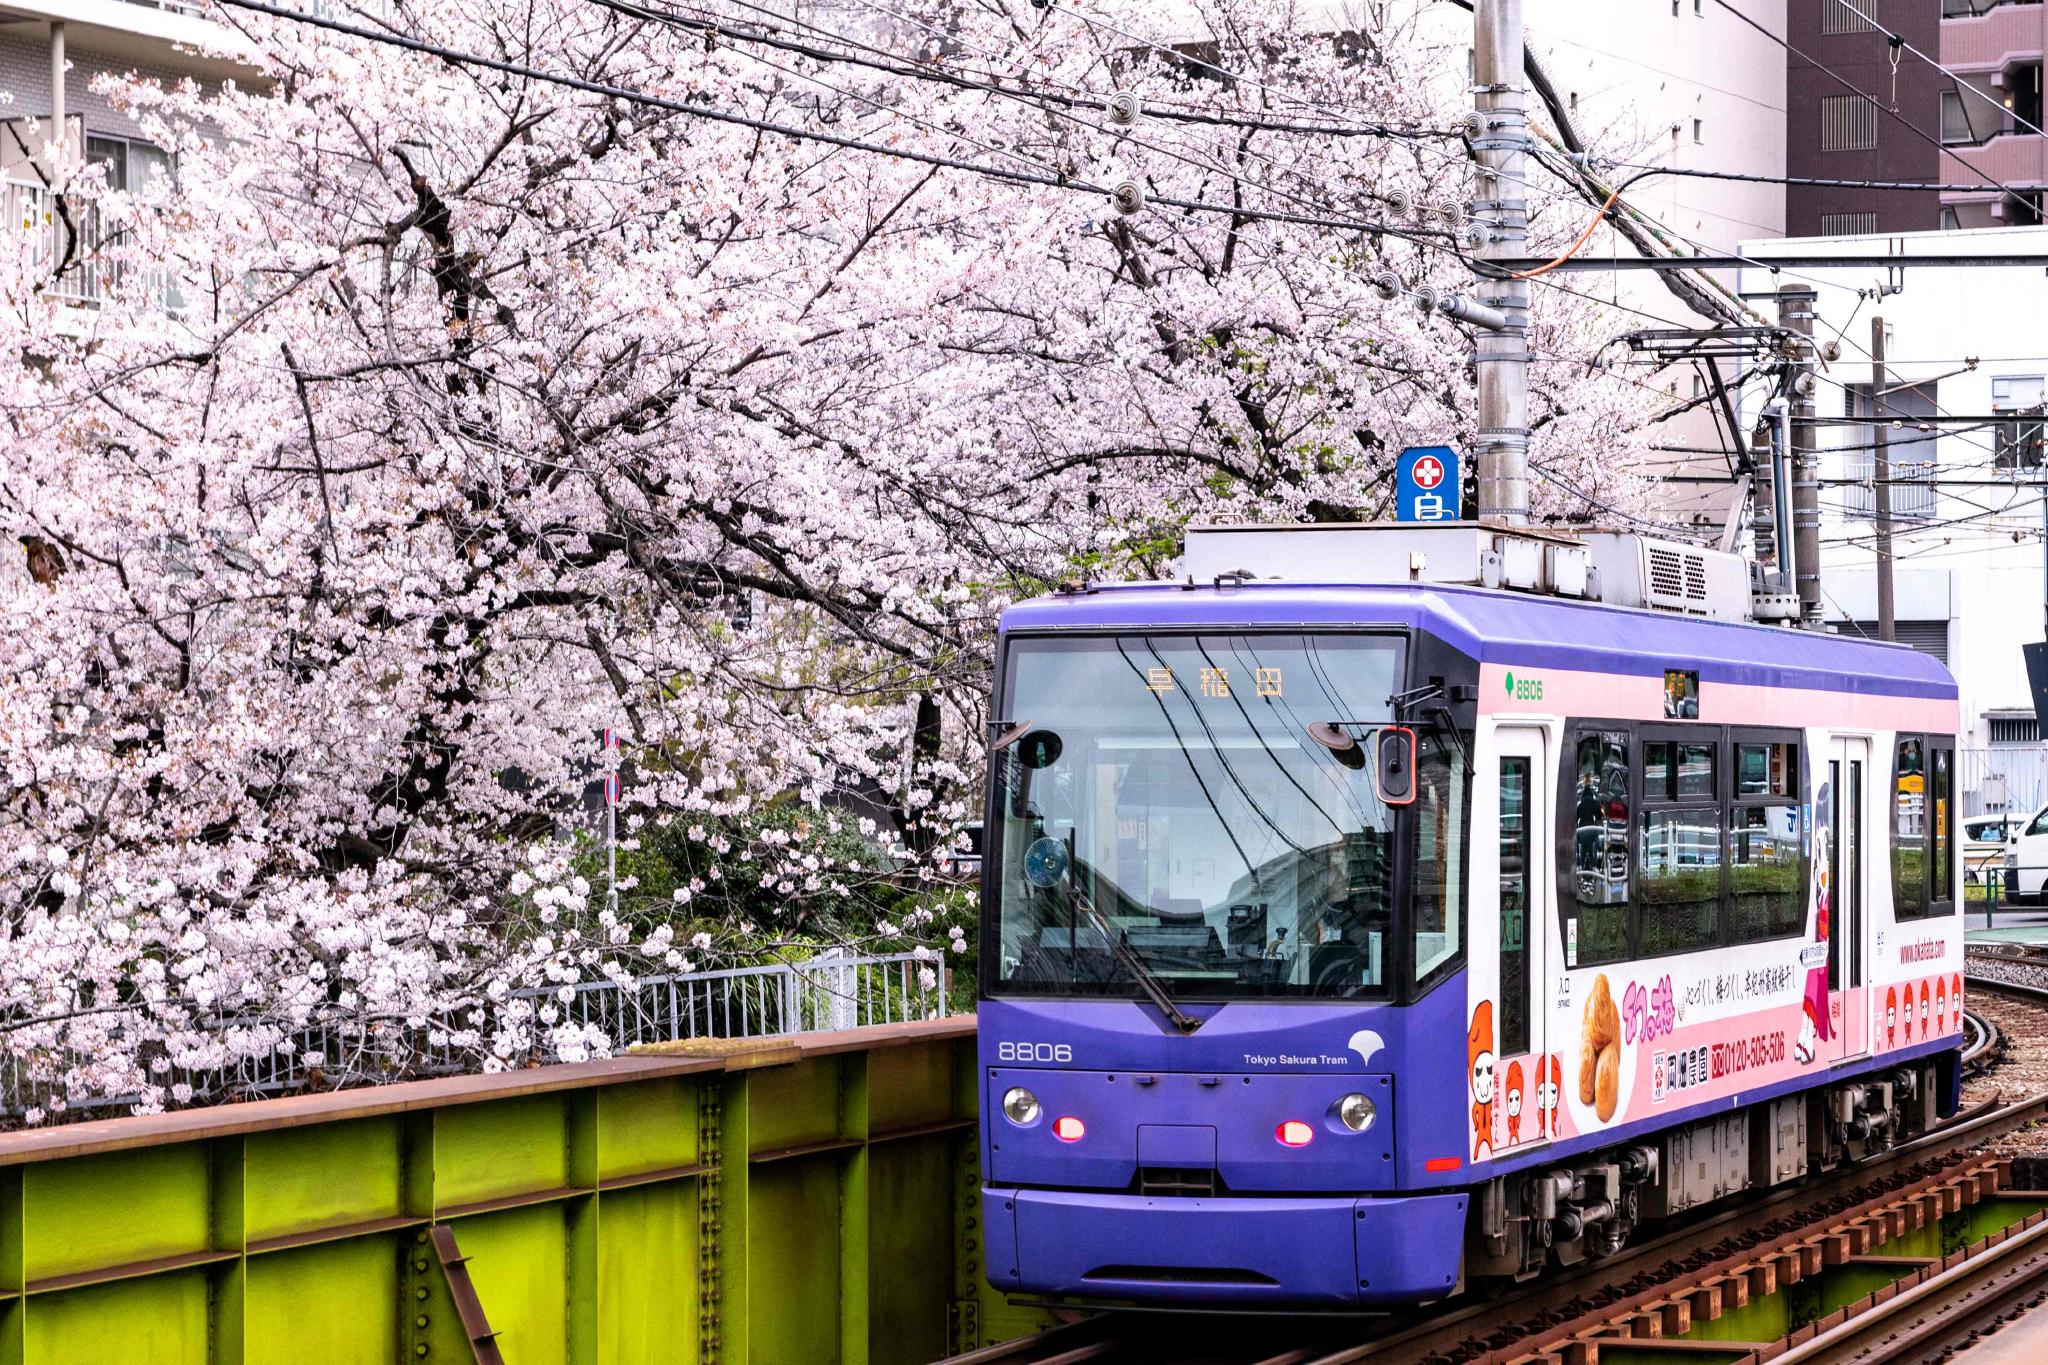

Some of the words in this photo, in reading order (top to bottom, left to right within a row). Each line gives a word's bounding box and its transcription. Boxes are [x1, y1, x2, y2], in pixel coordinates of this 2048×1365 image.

[1414, 491, 1443, 522] 白
[1146, 667, 1283, 699] 早稲田
[1517, 680, 1543, 700] 8806
[1900, 938, 1946, 964] www.okahata.com
[1559, 977, 1570, 995] 入口
[998, 1041, 1072, 1063] 8806
[1244, 1054, 1276, 1066] Tokyo
[1279, 1054, 1317, 1065] Sakura
[1320, 1054, 1348, 1065] Tram
[1724, 1031, 1784, 1075] 0120-505-506
